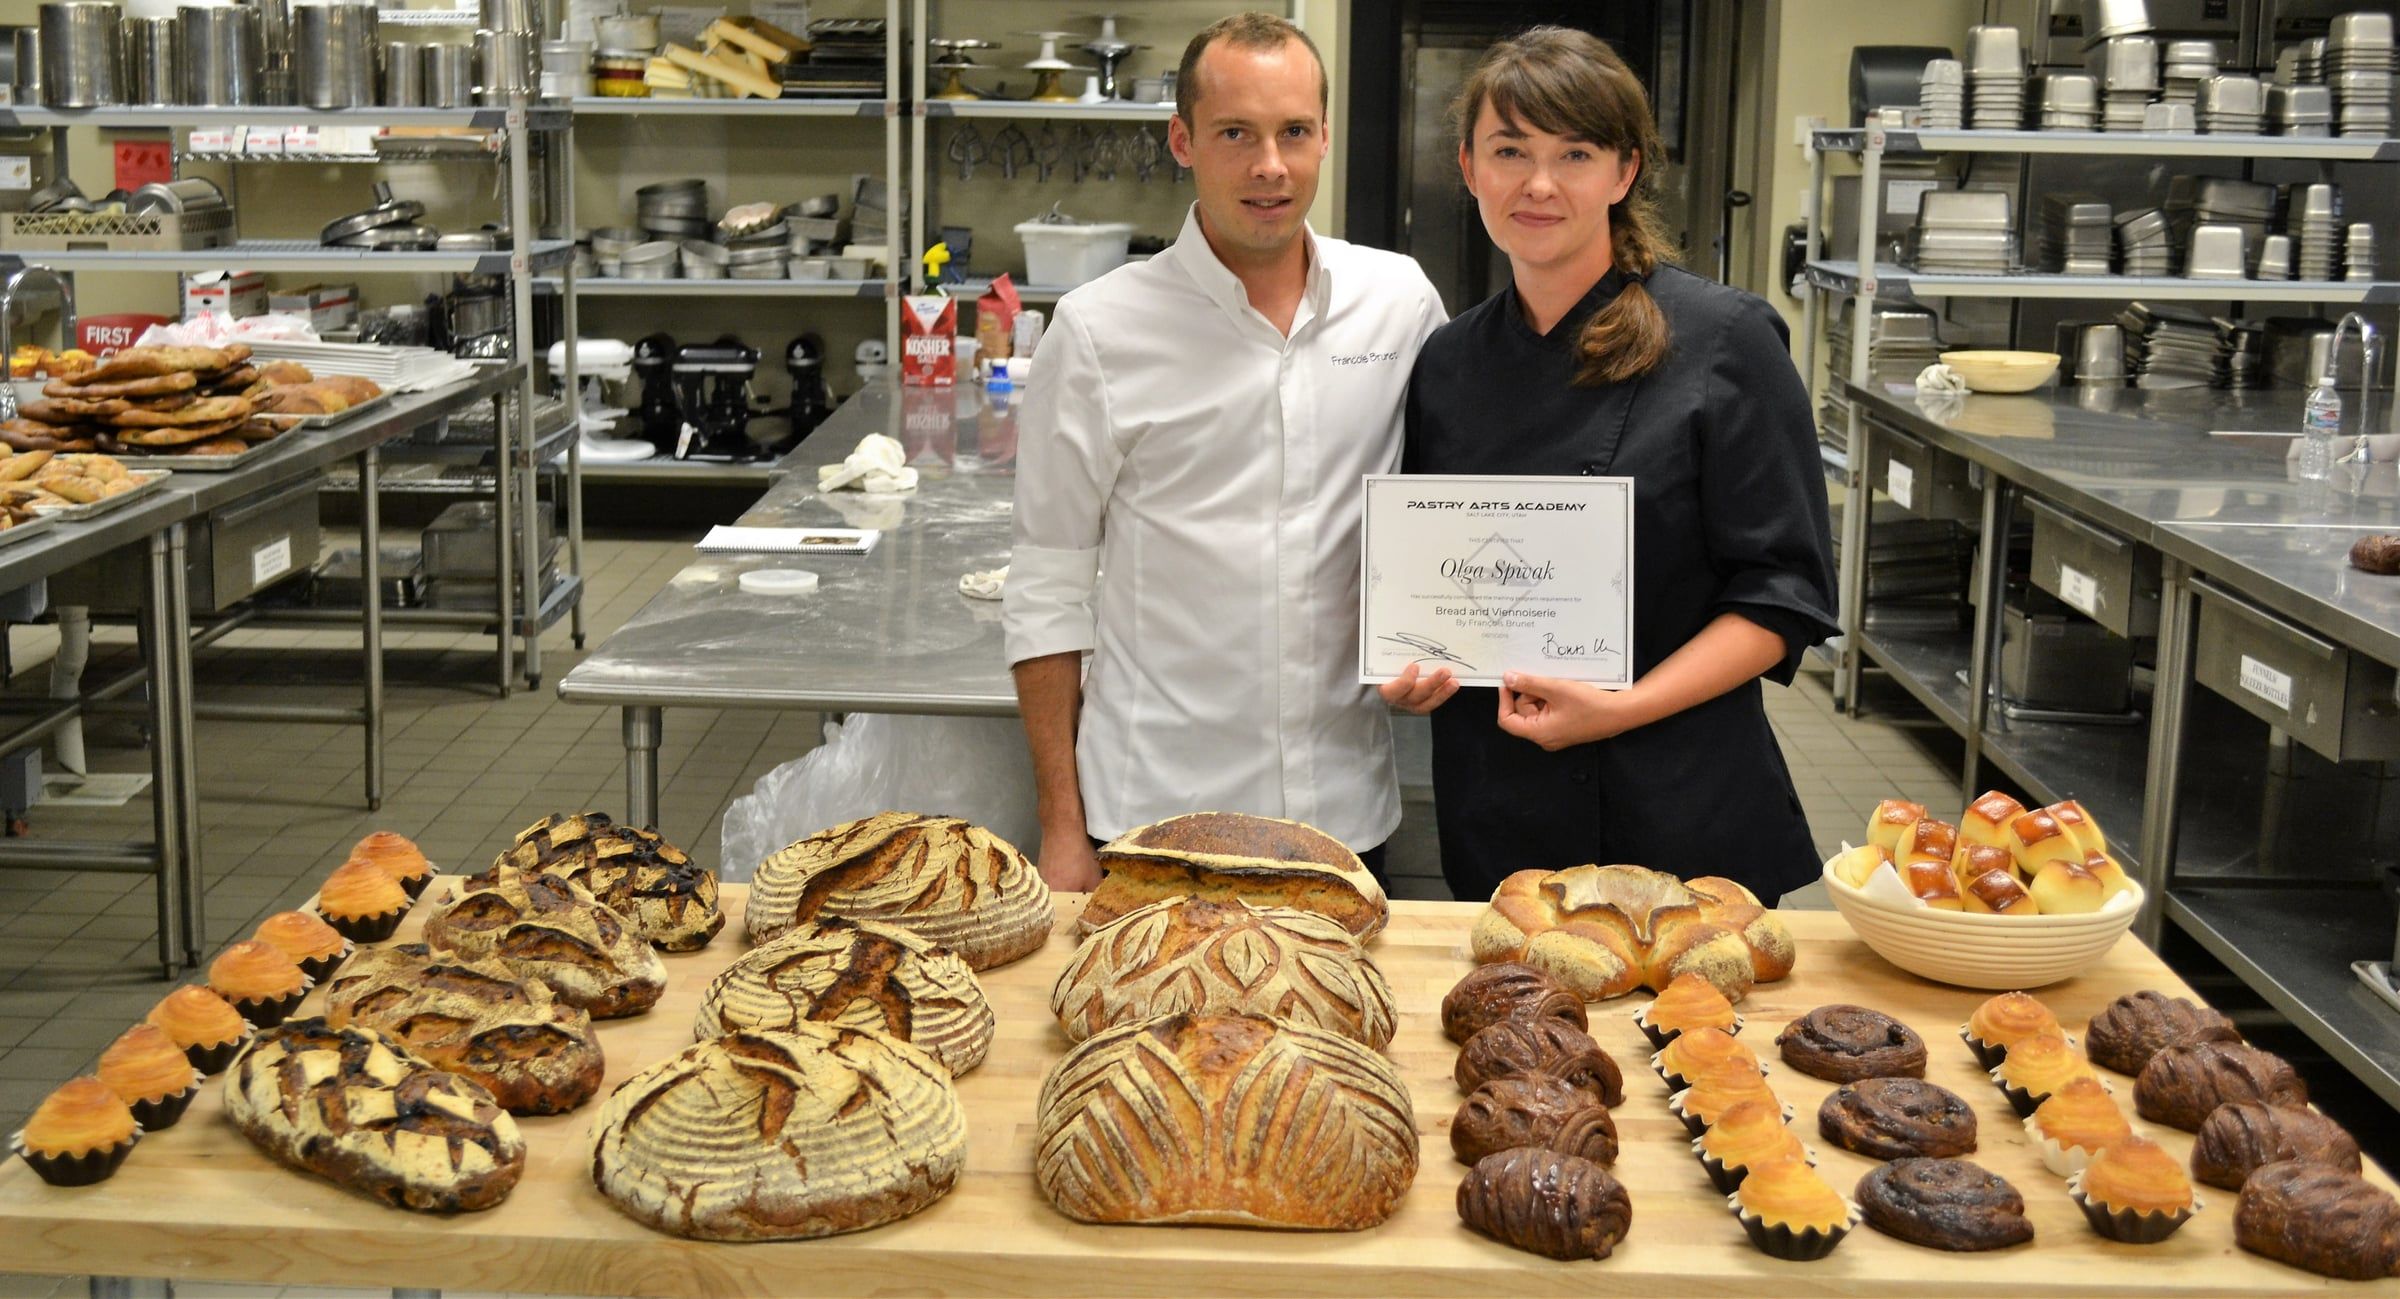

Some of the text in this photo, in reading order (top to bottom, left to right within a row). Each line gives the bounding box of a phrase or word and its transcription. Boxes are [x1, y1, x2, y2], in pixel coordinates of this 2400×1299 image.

[86, 325, 133, 346] FIRST
[906, 338, 950, 356] KOSHER
[1407, 501, 1587, 511] PASTRY ARTS ACADEMY
[1440, 558, 1555, 585] Olga Spivak
[1435, 606, 1556, 618] Bread and Viennoiserie
[1456, 619, 1466, 628] By
[1506, 620, 1535, 628] Brunet
